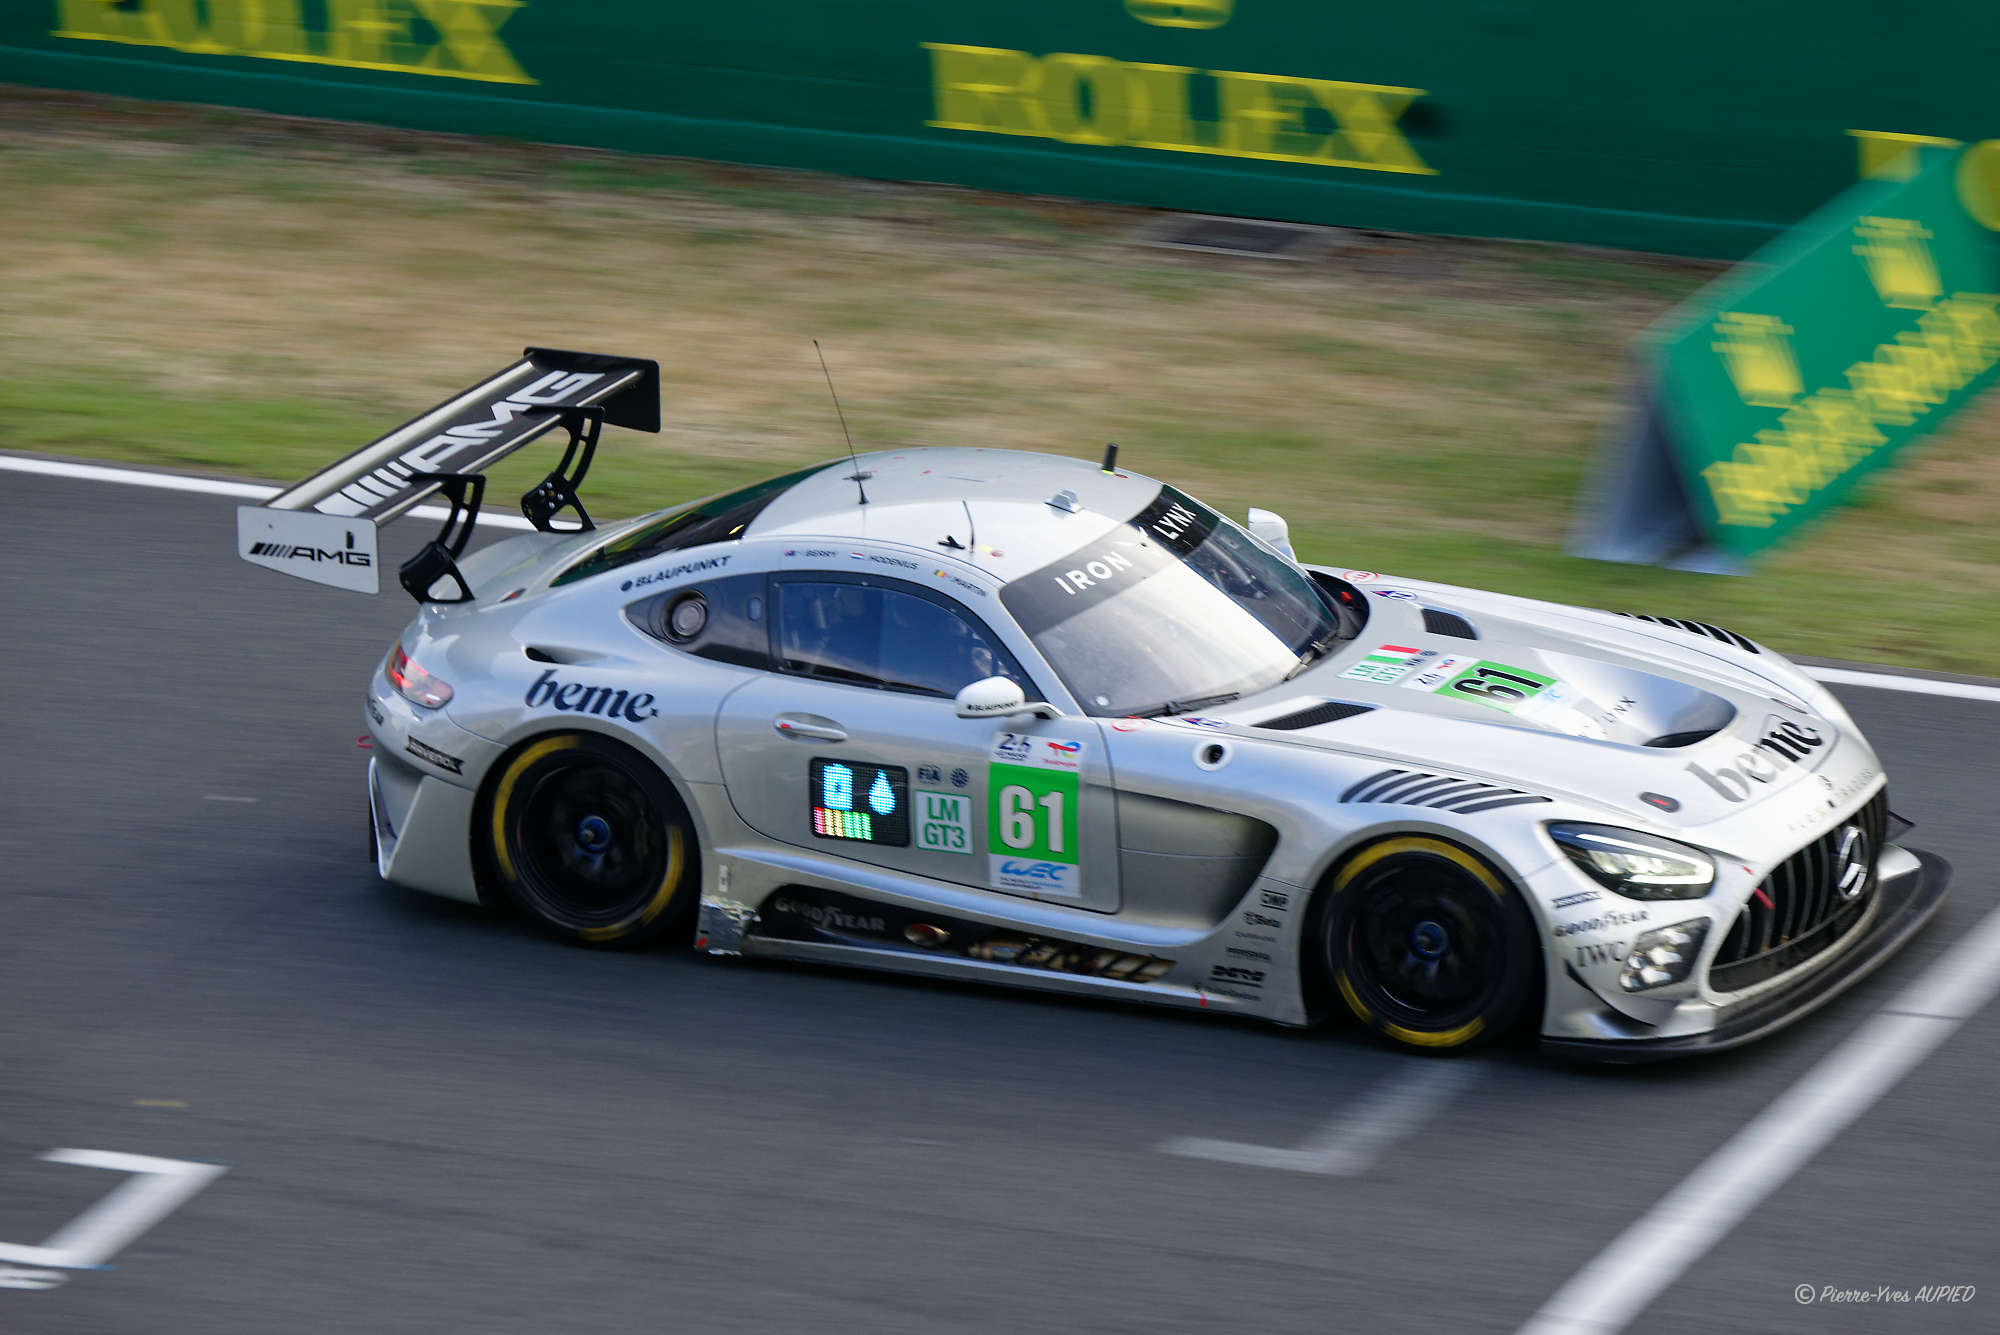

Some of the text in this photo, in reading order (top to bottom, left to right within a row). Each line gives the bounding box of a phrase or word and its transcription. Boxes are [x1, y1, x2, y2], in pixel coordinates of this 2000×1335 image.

[919, 42, 1440, 176] ROLEX
[399, 370, 606, 475] AMG
[288, 547, 372, 567] AMG
[1054, 501, 1197, 596] IRON LYNX
[635, 556, 732, 588] BLAUPUNKT
[524, 668, 656, 723] beme
[1451, 665, 1545, 704] 61
[927, 796, 961, 822] LM
[999, 784, 1065, 854] 61
[923, 821, 966, 849] GT3
[1000, 860, 1069, 881] WEC
[1575, 940, 1625, 968] IWC
